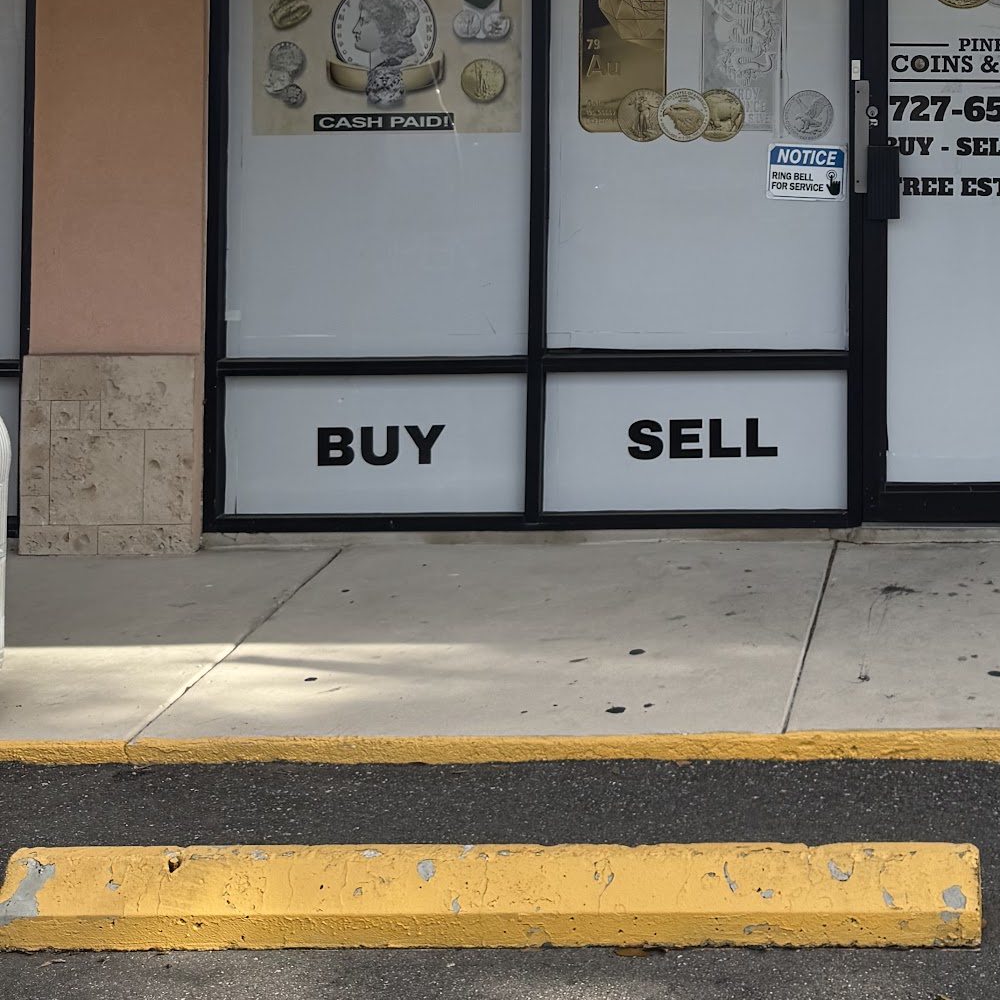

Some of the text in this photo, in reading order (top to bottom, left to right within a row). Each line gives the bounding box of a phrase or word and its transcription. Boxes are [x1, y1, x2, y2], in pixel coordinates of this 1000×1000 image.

[586, 39, 600, 49] 79
[586, 55, 622, 77] Au
[891, 55, 973, 73] COINS
[980, 56, 998, 73] &
[319, 116, 449, 128] CASH PAID!
[777, 149, 838, 165] NOTICE
[772, 172, 814, 182] RING BELL
[772, 182, 824, 192] FOR SERVICE
[899, 177, 953, 196] REE
[317, 426, 446, 466] BUY
[627, 420, 778, 458] SELL
